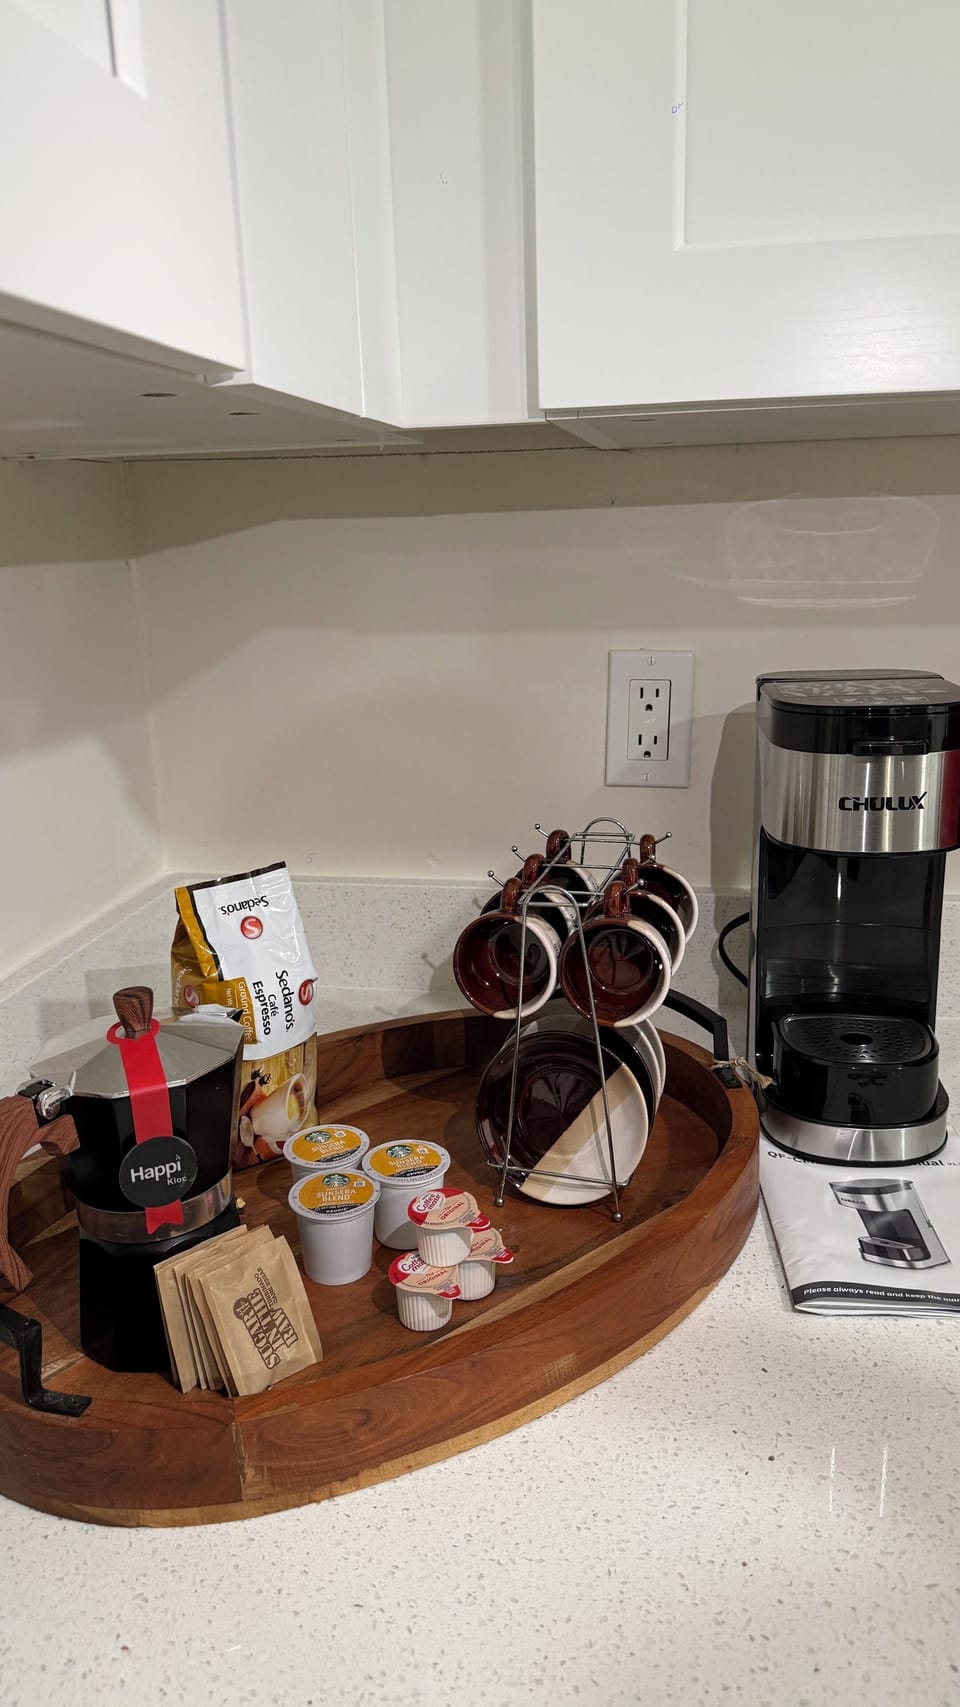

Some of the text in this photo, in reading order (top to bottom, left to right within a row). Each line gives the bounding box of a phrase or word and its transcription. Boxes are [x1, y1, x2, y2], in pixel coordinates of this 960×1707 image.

[838, 791, 928, 811] CHULUX
[239, 981, 251, 1014] Ground
[268, 993, 279, 1017] Café
[252, 980, 271, 1036] Espresso
[130, 1153, 181, 1183] Happi
[167, 1176, 187, 1186] Kloc
[322, 1194, 351, 1202] BLEND
[416, 1194, 436, 1212] Coffee
[427, 1194, 441, 1210] mate
[440, 1201, 465, 1220] ORIGINAL
[417, 1269, 449, 1286] ORIGINAL
[803, 1287, 832, 1296] Please
[833, 1286, 863, 1294] always
[247, 1288, 285, 1352] IN THE
[269, 1307, 298, 1348] RAW
[243, 1309, 281, 1370] SUGAR
